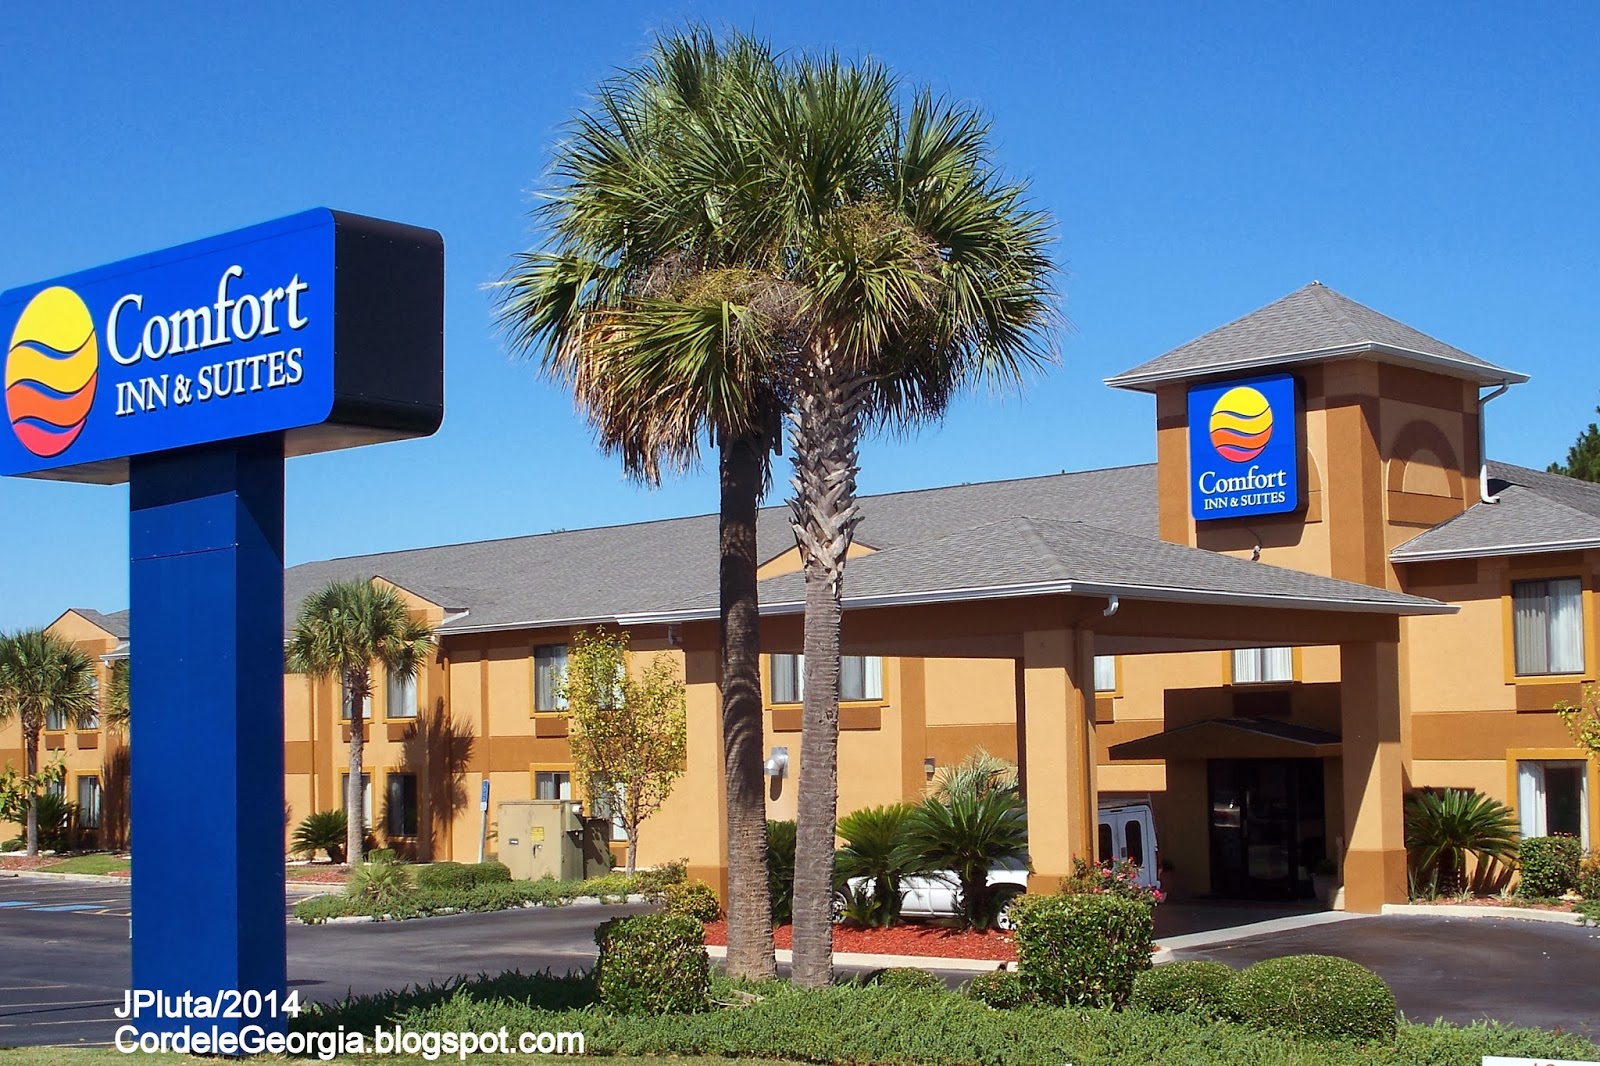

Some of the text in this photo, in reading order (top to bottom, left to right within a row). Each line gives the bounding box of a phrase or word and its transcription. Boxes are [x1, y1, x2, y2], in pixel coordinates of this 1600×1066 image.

[107, 264, 309, 365] Comfort
[115, 347, 303, 416] INN & SUITES
[1199, 465, 1287, 495] Comfort
[1204, 491, 1286, 510] INN & SUITES
